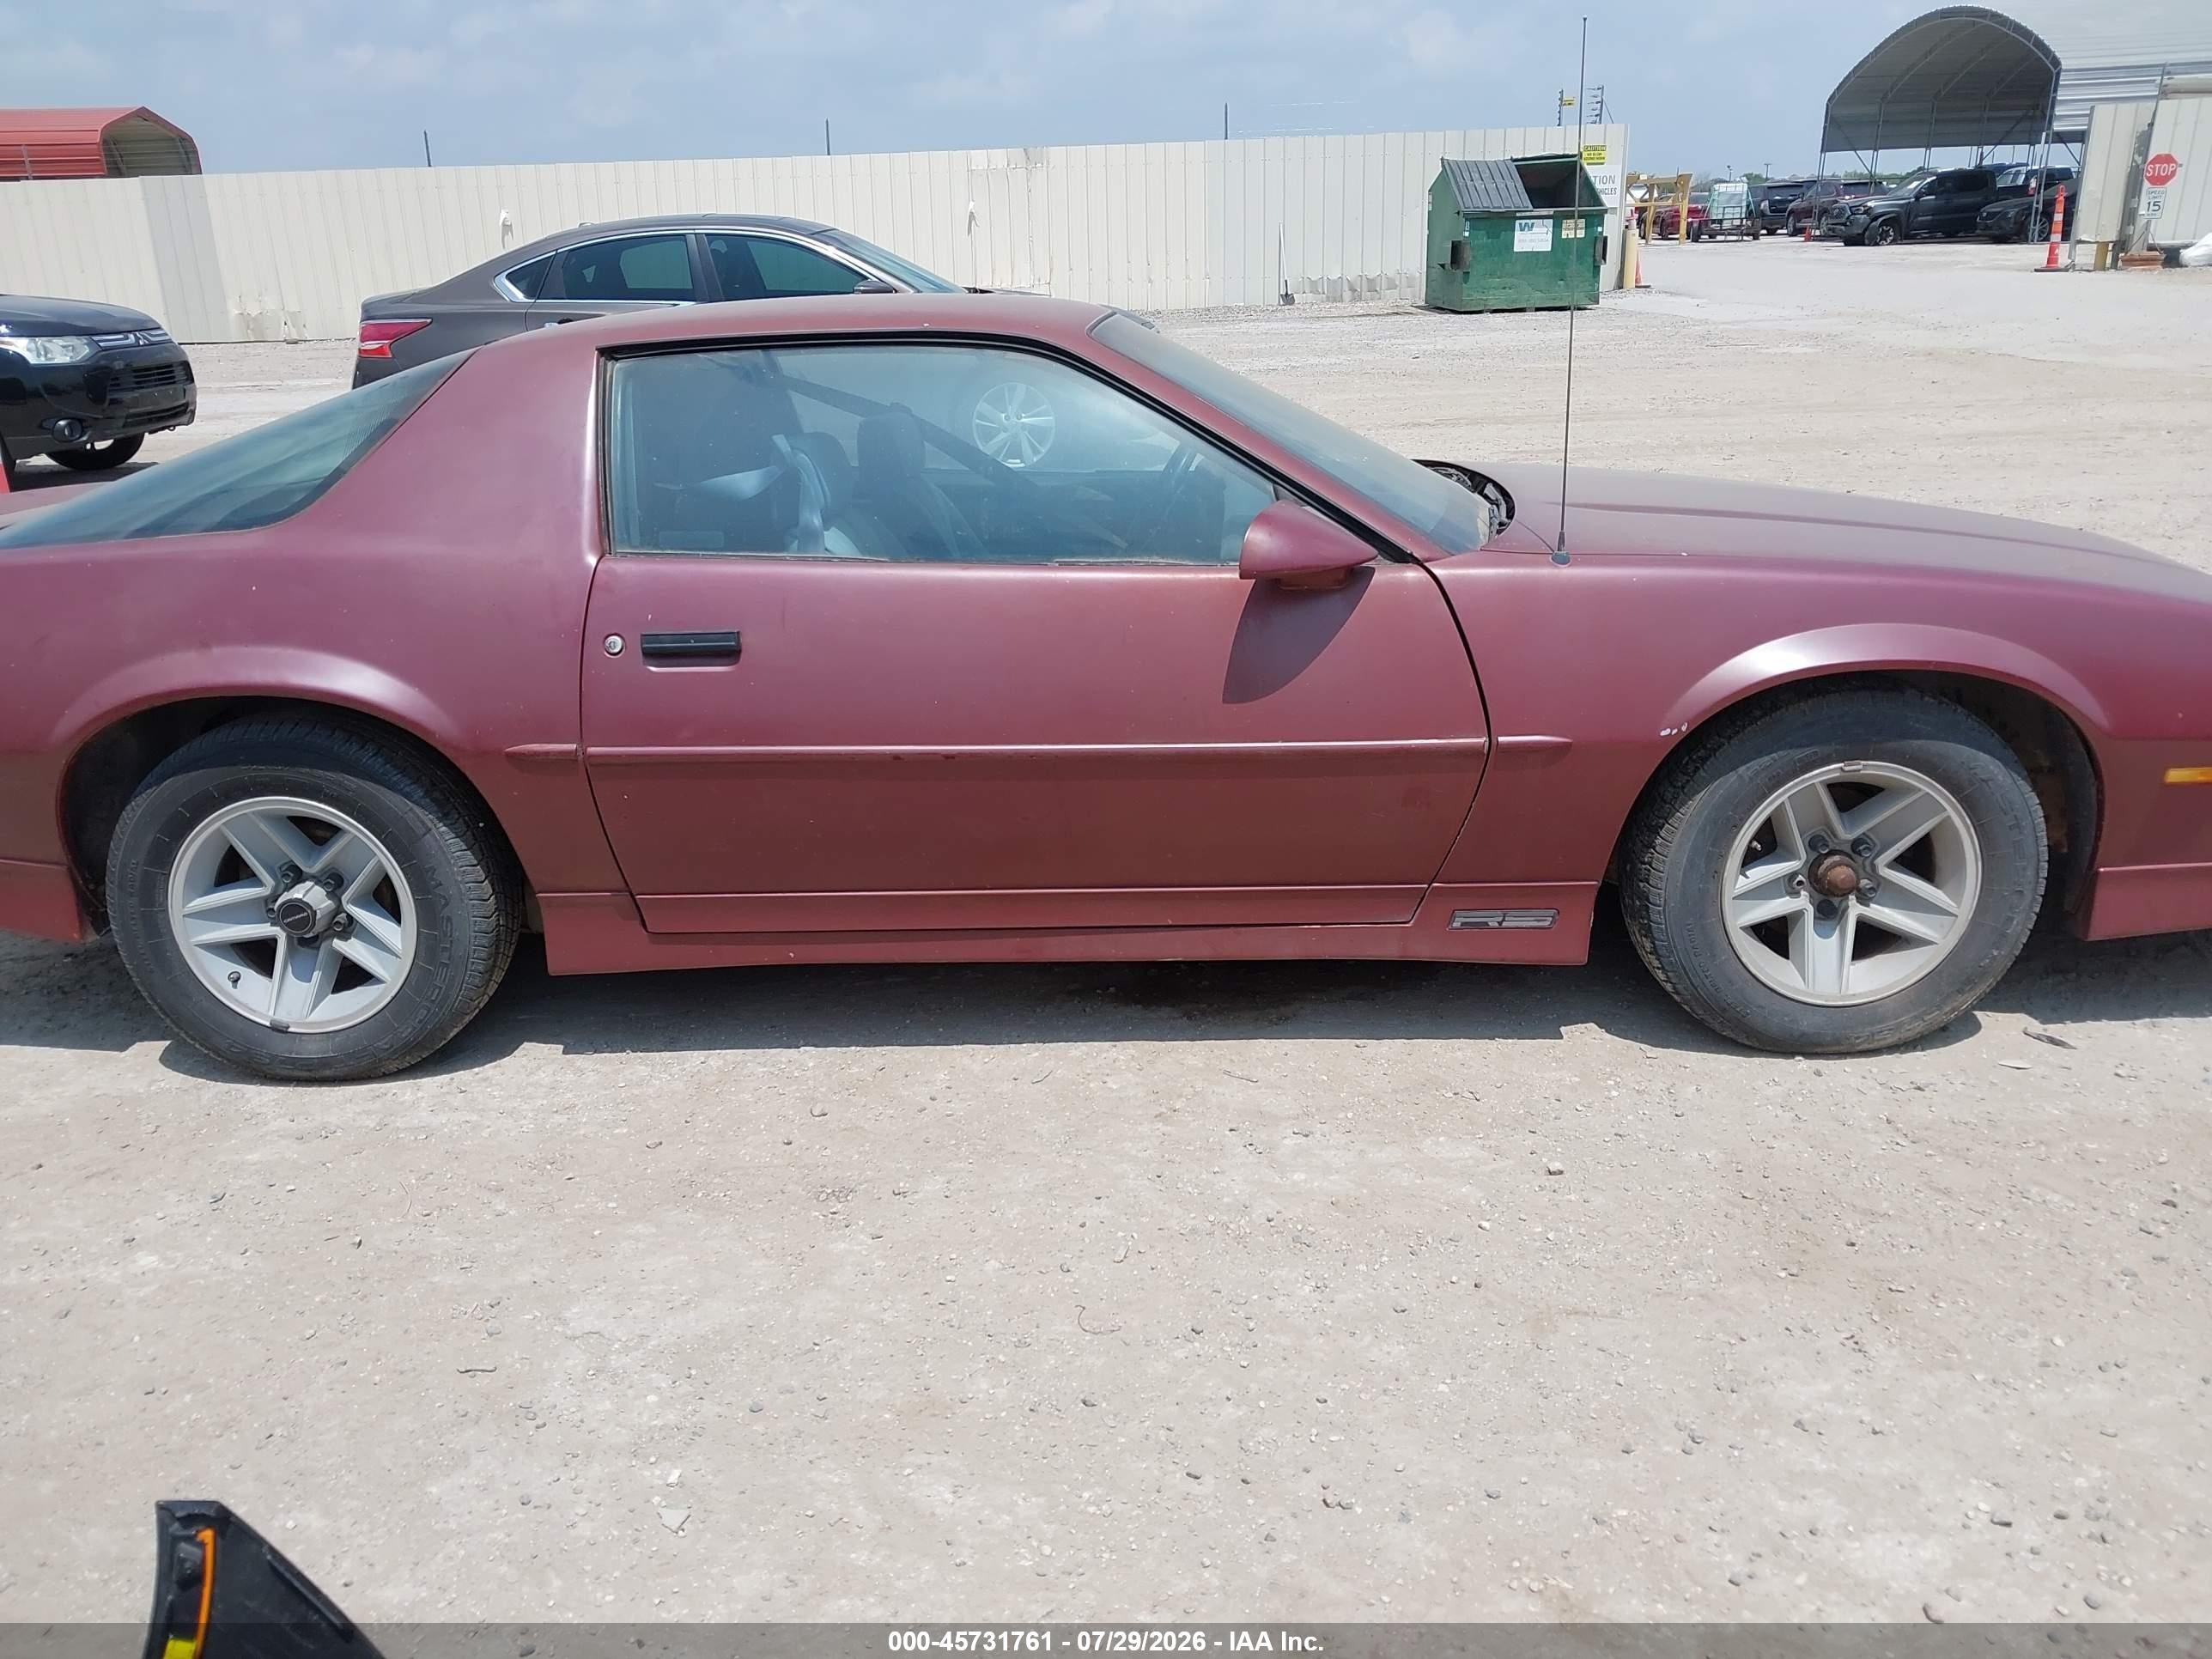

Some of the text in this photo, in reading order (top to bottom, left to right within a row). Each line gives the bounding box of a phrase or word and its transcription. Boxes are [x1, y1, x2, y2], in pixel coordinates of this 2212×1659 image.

[2147, 163, 2176, 177] STOP
[1593, 174, 1615, 185] TION
[2147, 200, 2162, 212] 15
[1451, 911, 1554, 927] RS
